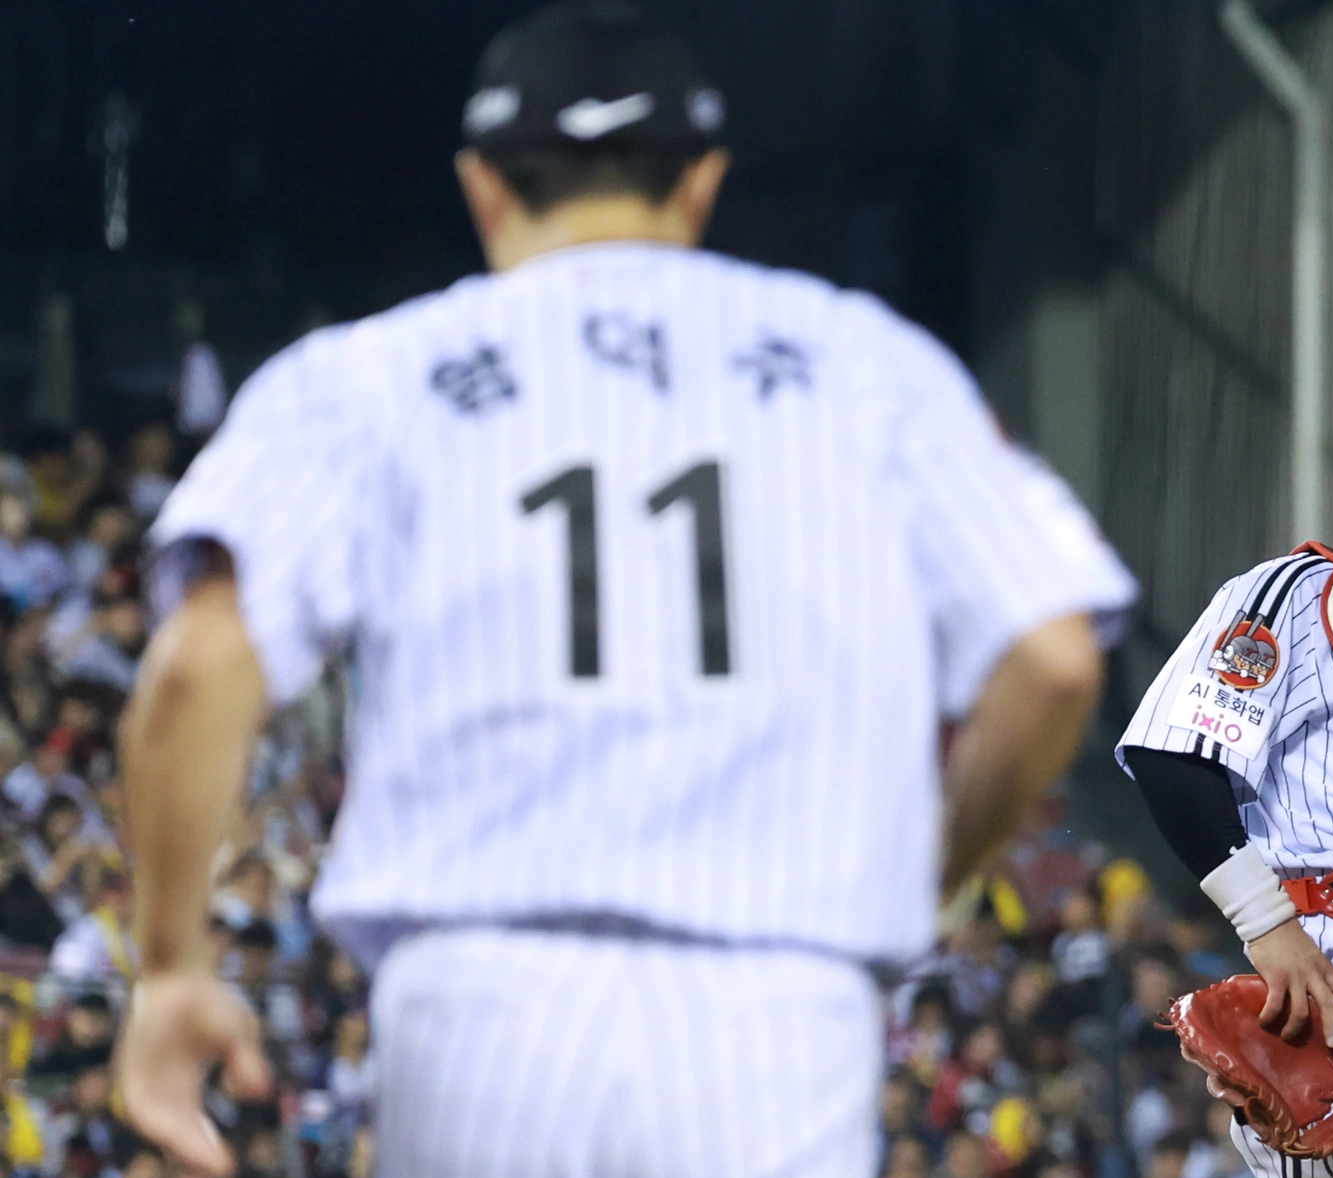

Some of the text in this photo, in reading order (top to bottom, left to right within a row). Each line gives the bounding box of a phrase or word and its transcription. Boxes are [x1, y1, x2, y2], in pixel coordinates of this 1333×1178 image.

[519, 459, 733, 679] 11
[1189, 682, 1265, 727] AI 통화앱
